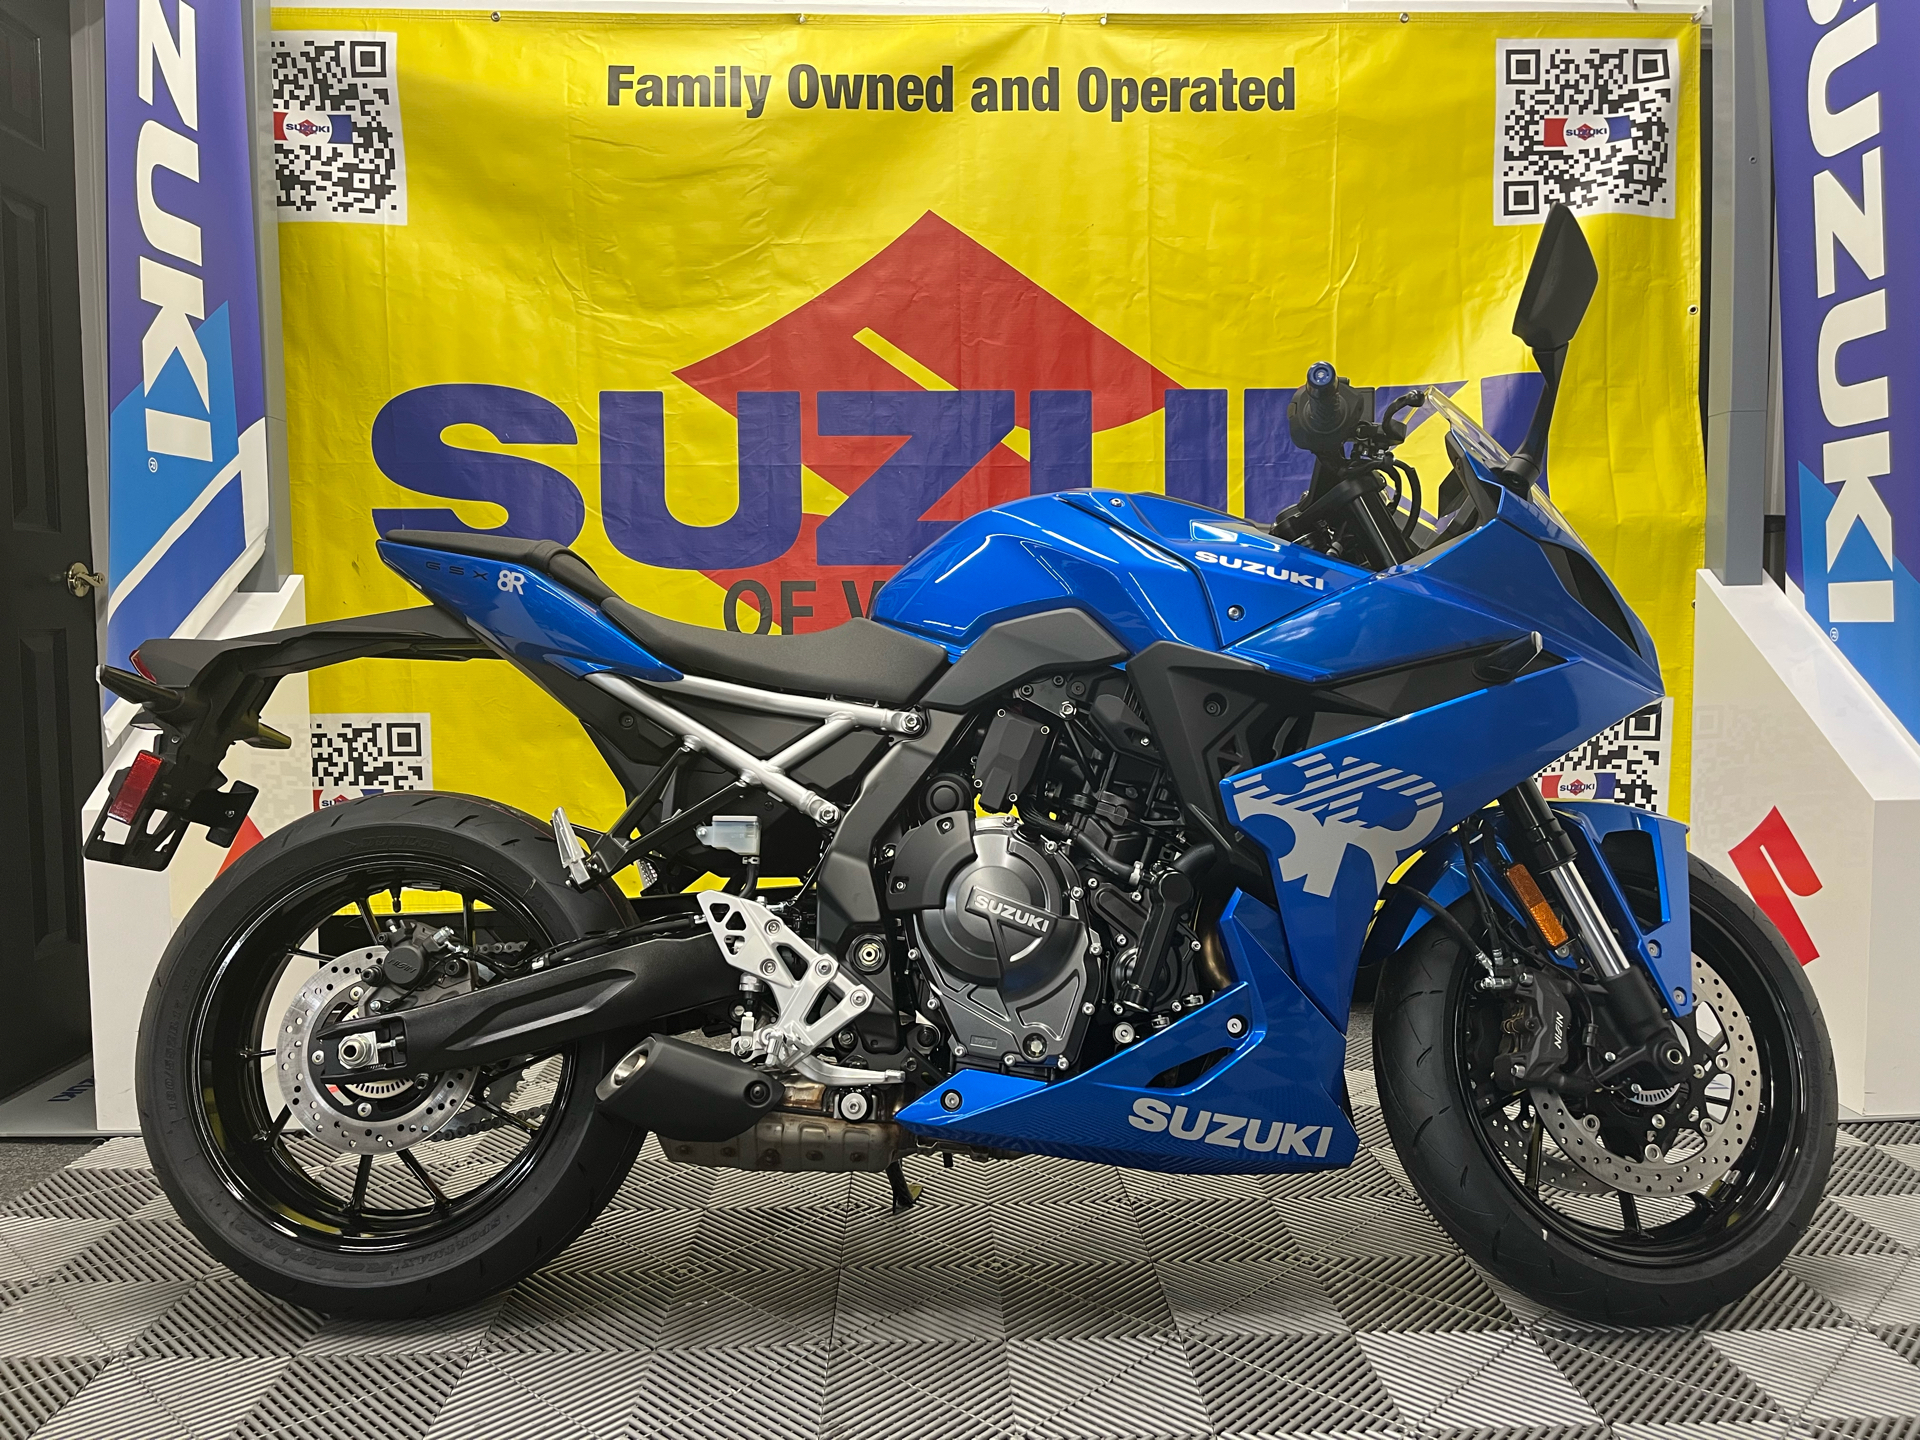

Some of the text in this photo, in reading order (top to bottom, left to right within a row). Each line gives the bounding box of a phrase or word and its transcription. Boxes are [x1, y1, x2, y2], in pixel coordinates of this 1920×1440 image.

[607, 64, 1295, 123] Family Owned and Operated
[286, 123, 330, 133] SUZUKI
[1566, 127, 1607, 137] SUZUKI
[1807, 0, 1894, 623] UZUKI
[497, 569, 526, 596] 8R
[1194, 550, 1324, 591] SUZUKI
[723, 579, 816, 635] OF
[1560, 783, 1595, 792] SUZUKI
[974, 895, 1050, 933] SUZUKI
[1128, 1097, 1334, 1158] SUZUKI
